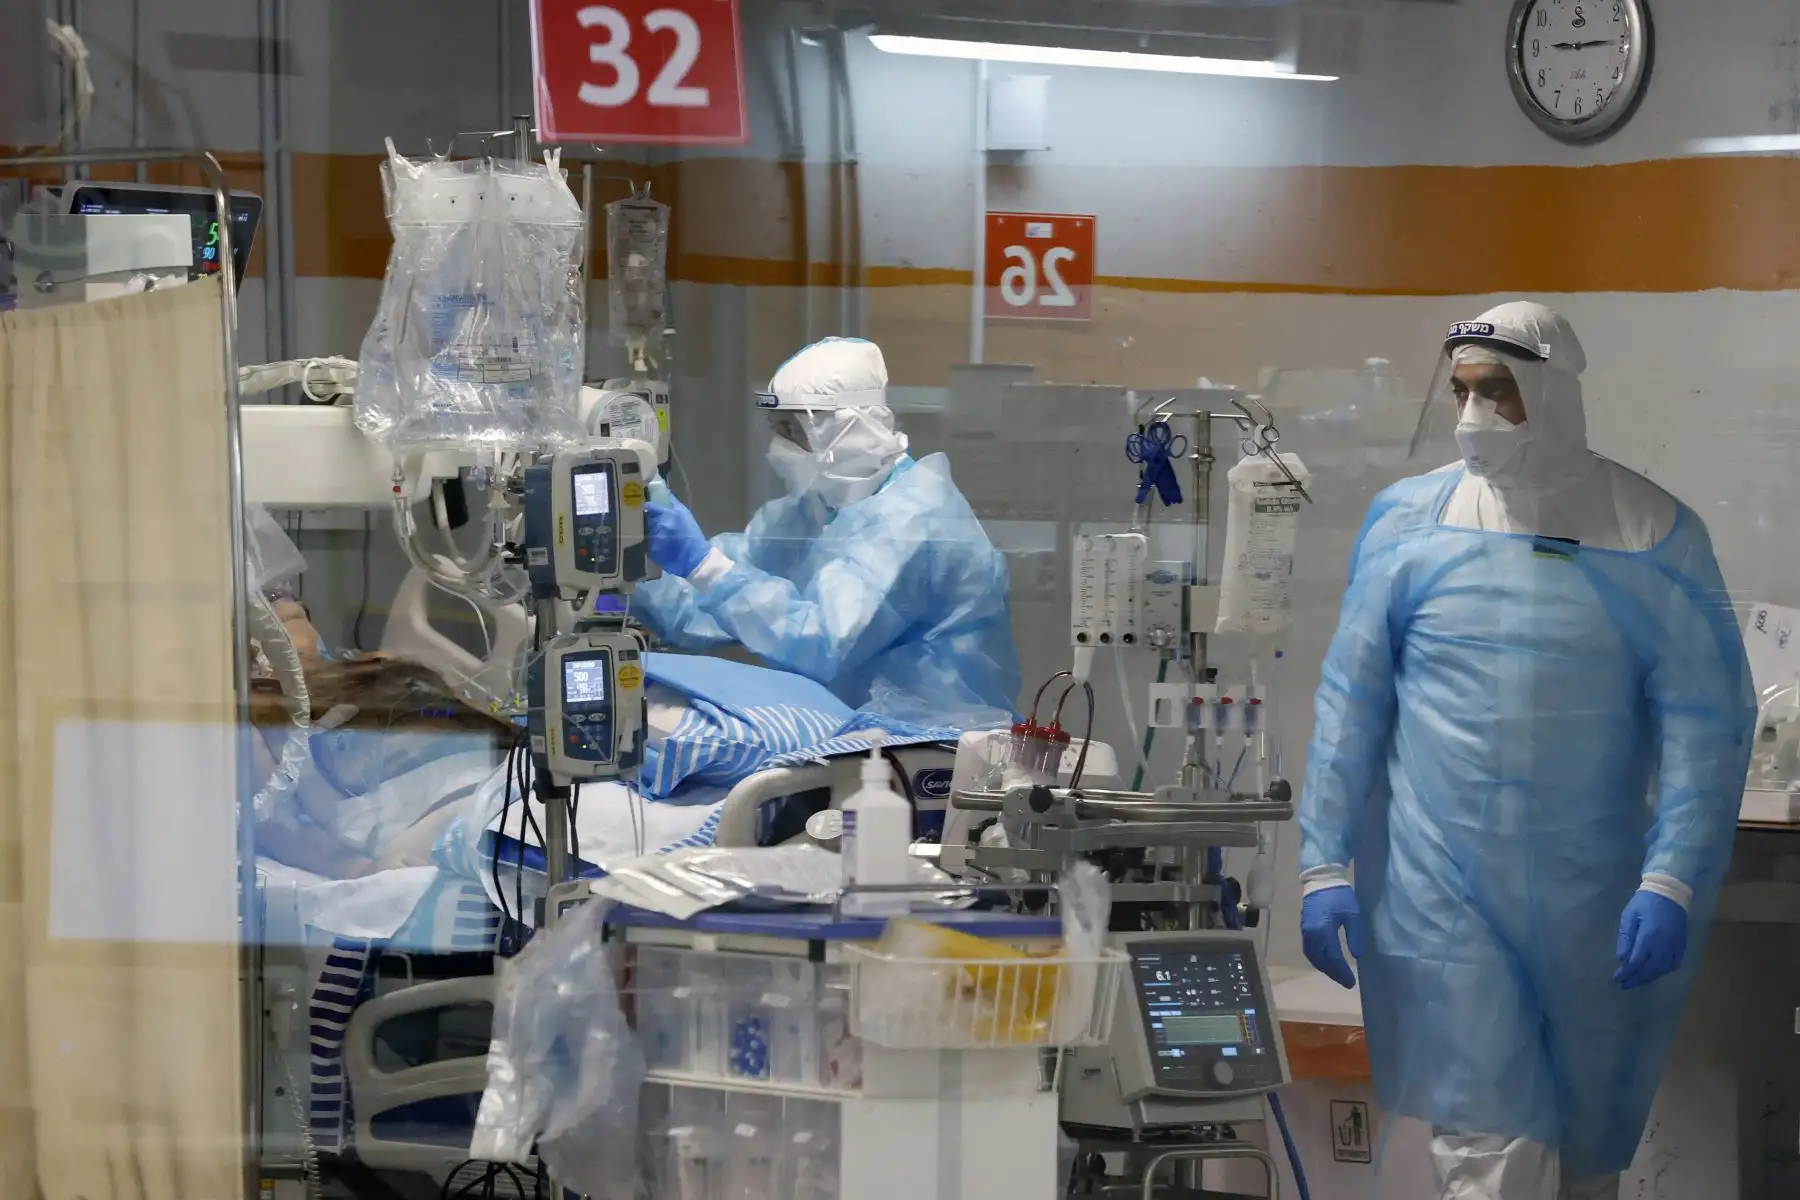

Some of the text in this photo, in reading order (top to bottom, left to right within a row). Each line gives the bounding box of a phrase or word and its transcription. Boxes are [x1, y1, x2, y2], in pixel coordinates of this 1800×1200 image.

[1536, 9, 1547, 27] 10
[576, 5, 709, 107] 32
[1532, 38, 1540, 57] 9
[1538, 69, 1545, 87] 8
[1554, 90, 1561, 108] 7
[1574, 97, 1582, 115] 6
[1595, 88, 1603, 107] 5
[1458, 323, 1489, 334] משקף
